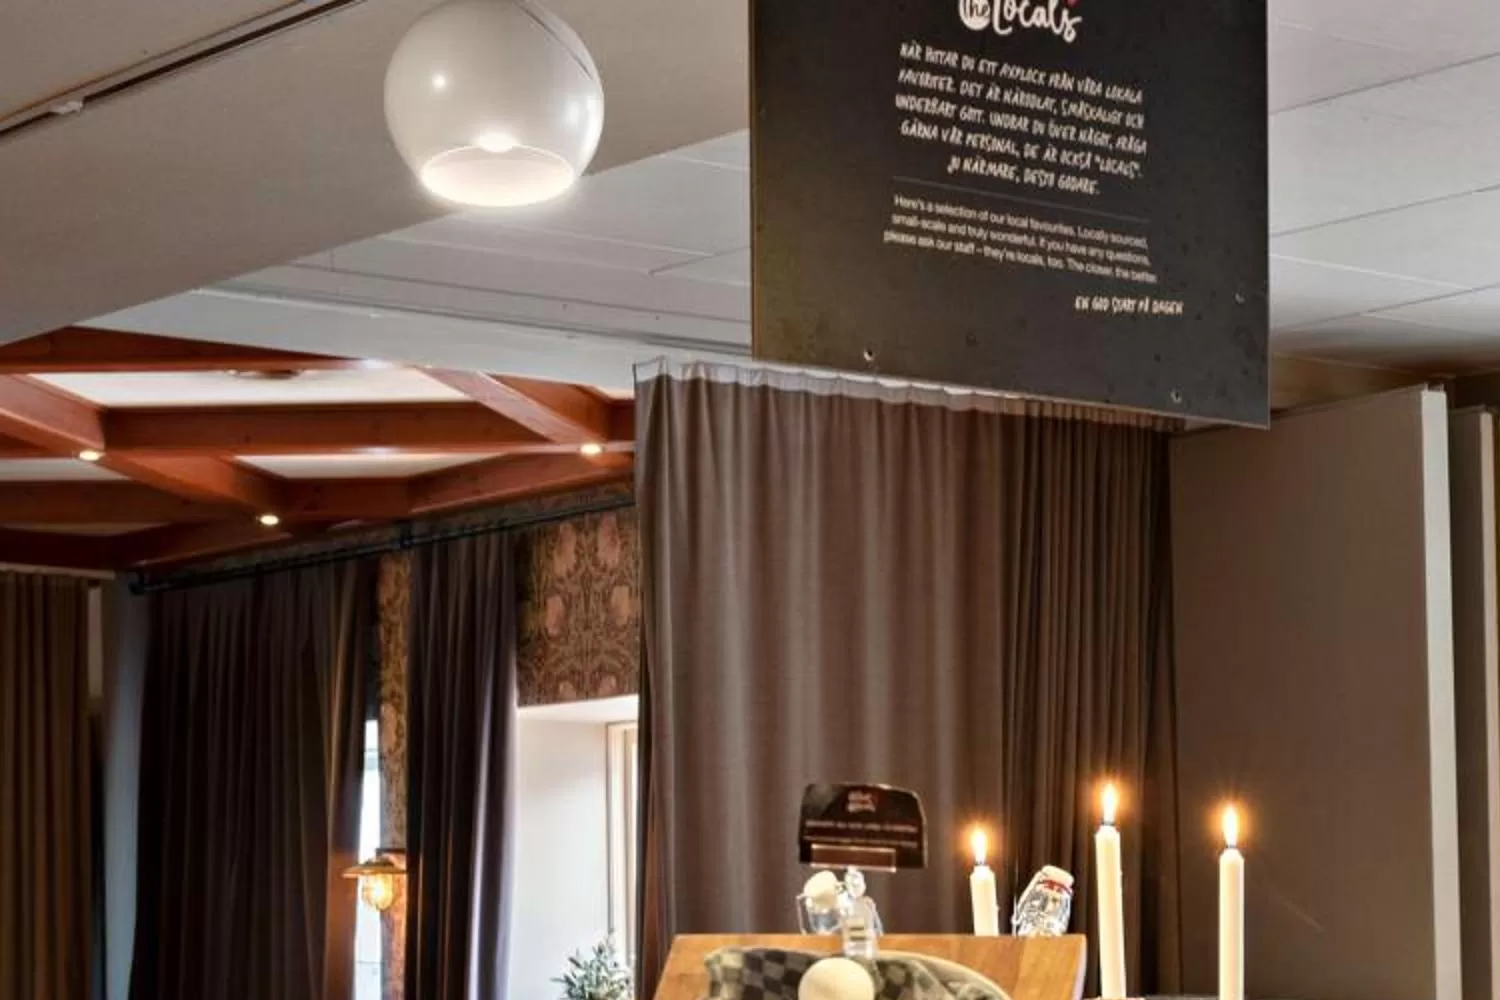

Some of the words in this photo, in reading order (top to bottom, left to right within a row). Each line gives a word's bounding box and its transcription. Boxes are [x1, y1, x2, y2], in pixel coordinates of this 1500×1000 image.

[900, 40, 922, 59] HÄR
[961, 54, 975, 71] DU
[978, 58, 998, 76] ETT
[1048, 72, 1075, 91] FRÅN
[959, 80, 983, 98] DET
[985, 82, 1001, 101] ÄR
[1125, 111, 1144, 129] OCH
[989, 111, 1029, 132] UNDRAR
[1031, 119, 1045, 136] DU
[1047, 118, 1076, 141] ÖVER
[901, 118, 938, 139] GÄRNA
[941, 126, 963, 144] VÅR
[965, 133, 1020, 158] PERSONAL,
[1023, 142, 1040, 159] DE
[1043, 143, 1058, 162] ÄR
[947, 222, 967, 236] and
[1065, 240, 1087, 256] have
